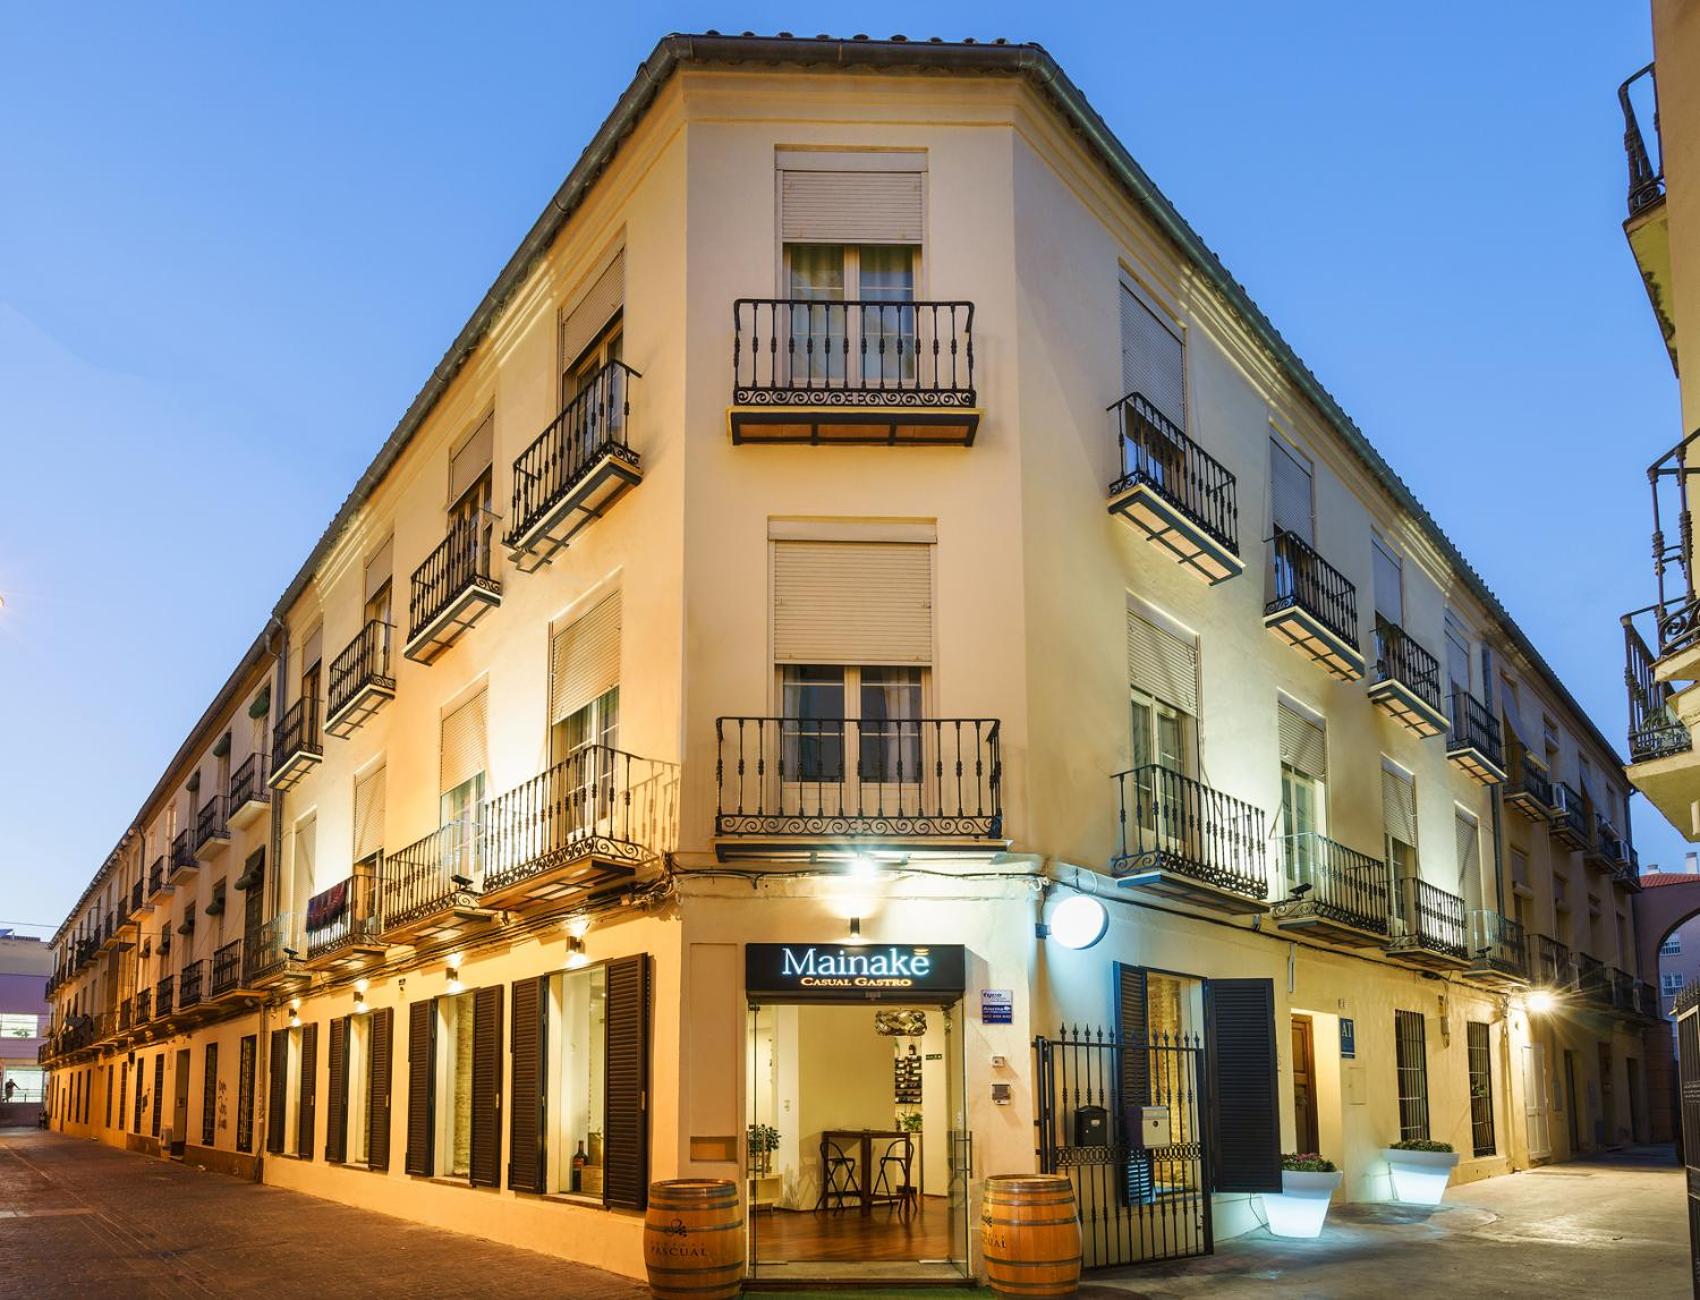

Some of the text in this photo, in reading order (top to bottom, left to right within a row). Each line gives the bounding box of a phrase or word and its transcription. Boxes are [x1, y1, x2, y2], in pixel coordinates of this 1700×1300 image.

[800, 977, 912, 987] CASUAL GASTRO
[1341, 1021, 1353, 1038] AT
